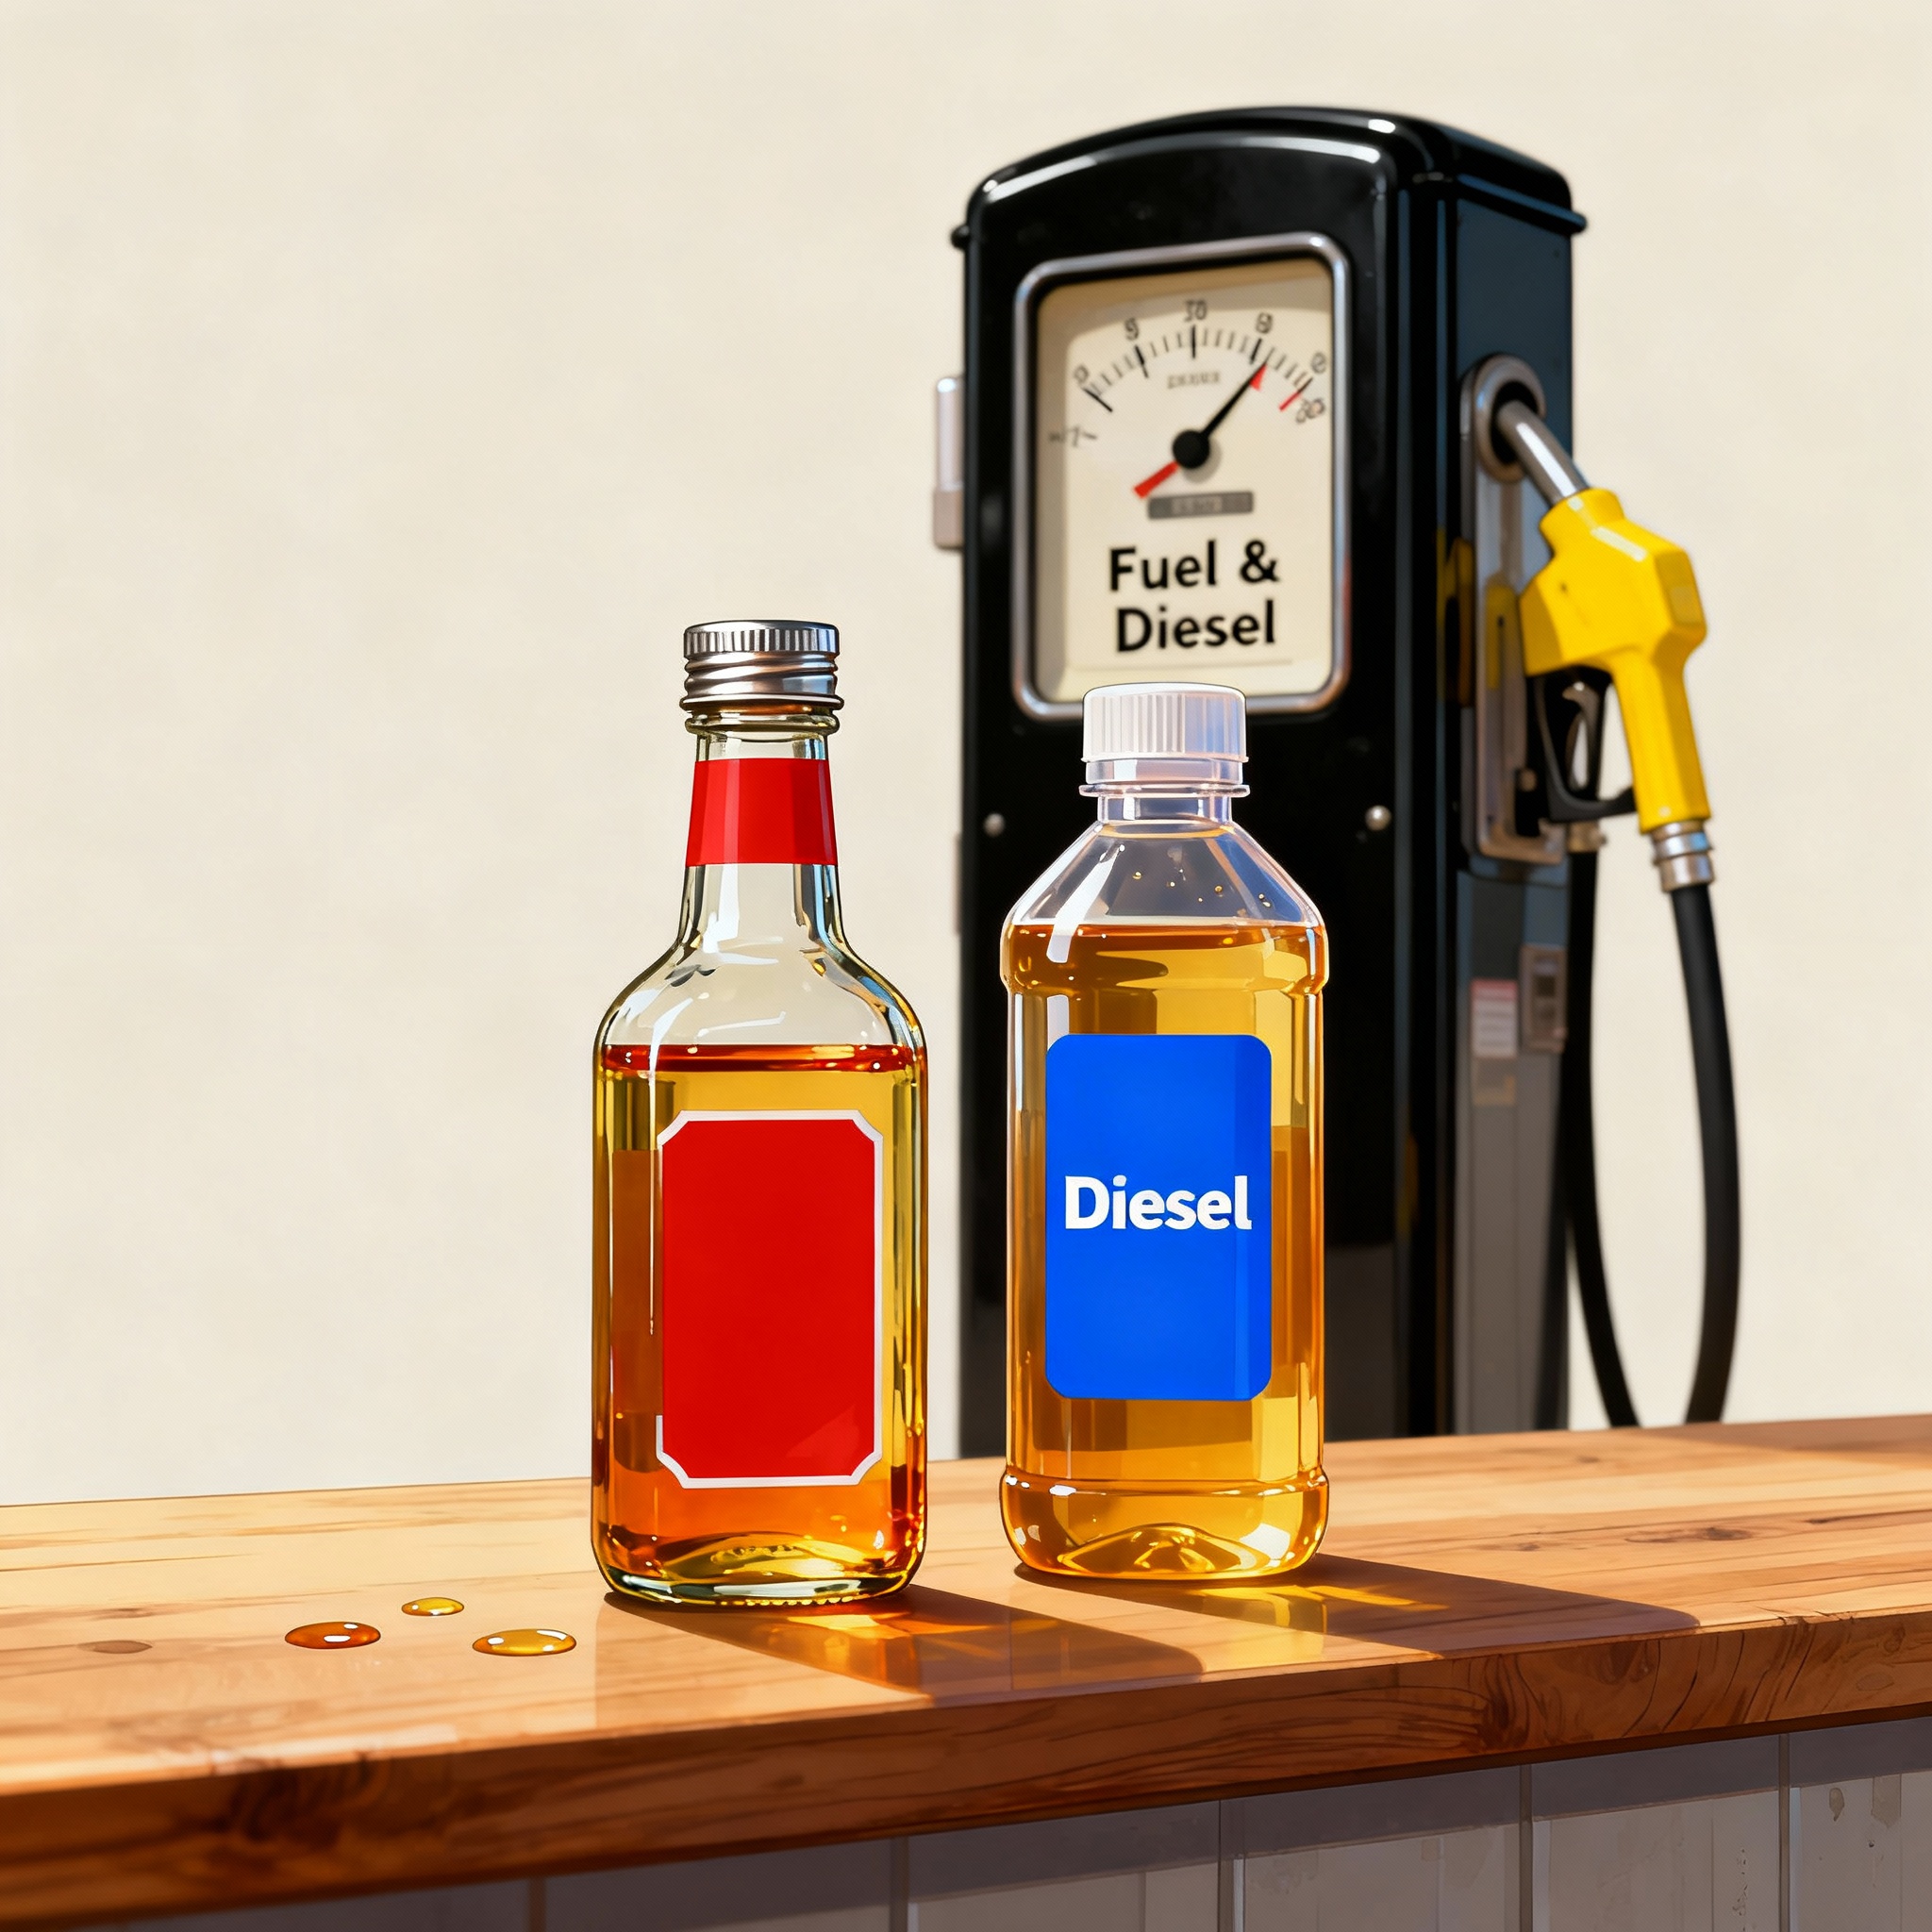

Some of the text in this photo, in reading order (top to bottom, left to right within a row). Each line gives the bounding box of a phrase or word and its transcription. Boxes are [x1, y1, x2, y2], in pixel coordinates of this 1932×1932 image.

[1109, 539, 1280, 593] Fuel &
[1116, 598, 1276, 654] Diesel
[1065, 1174, 1253, 1230] Diesel
